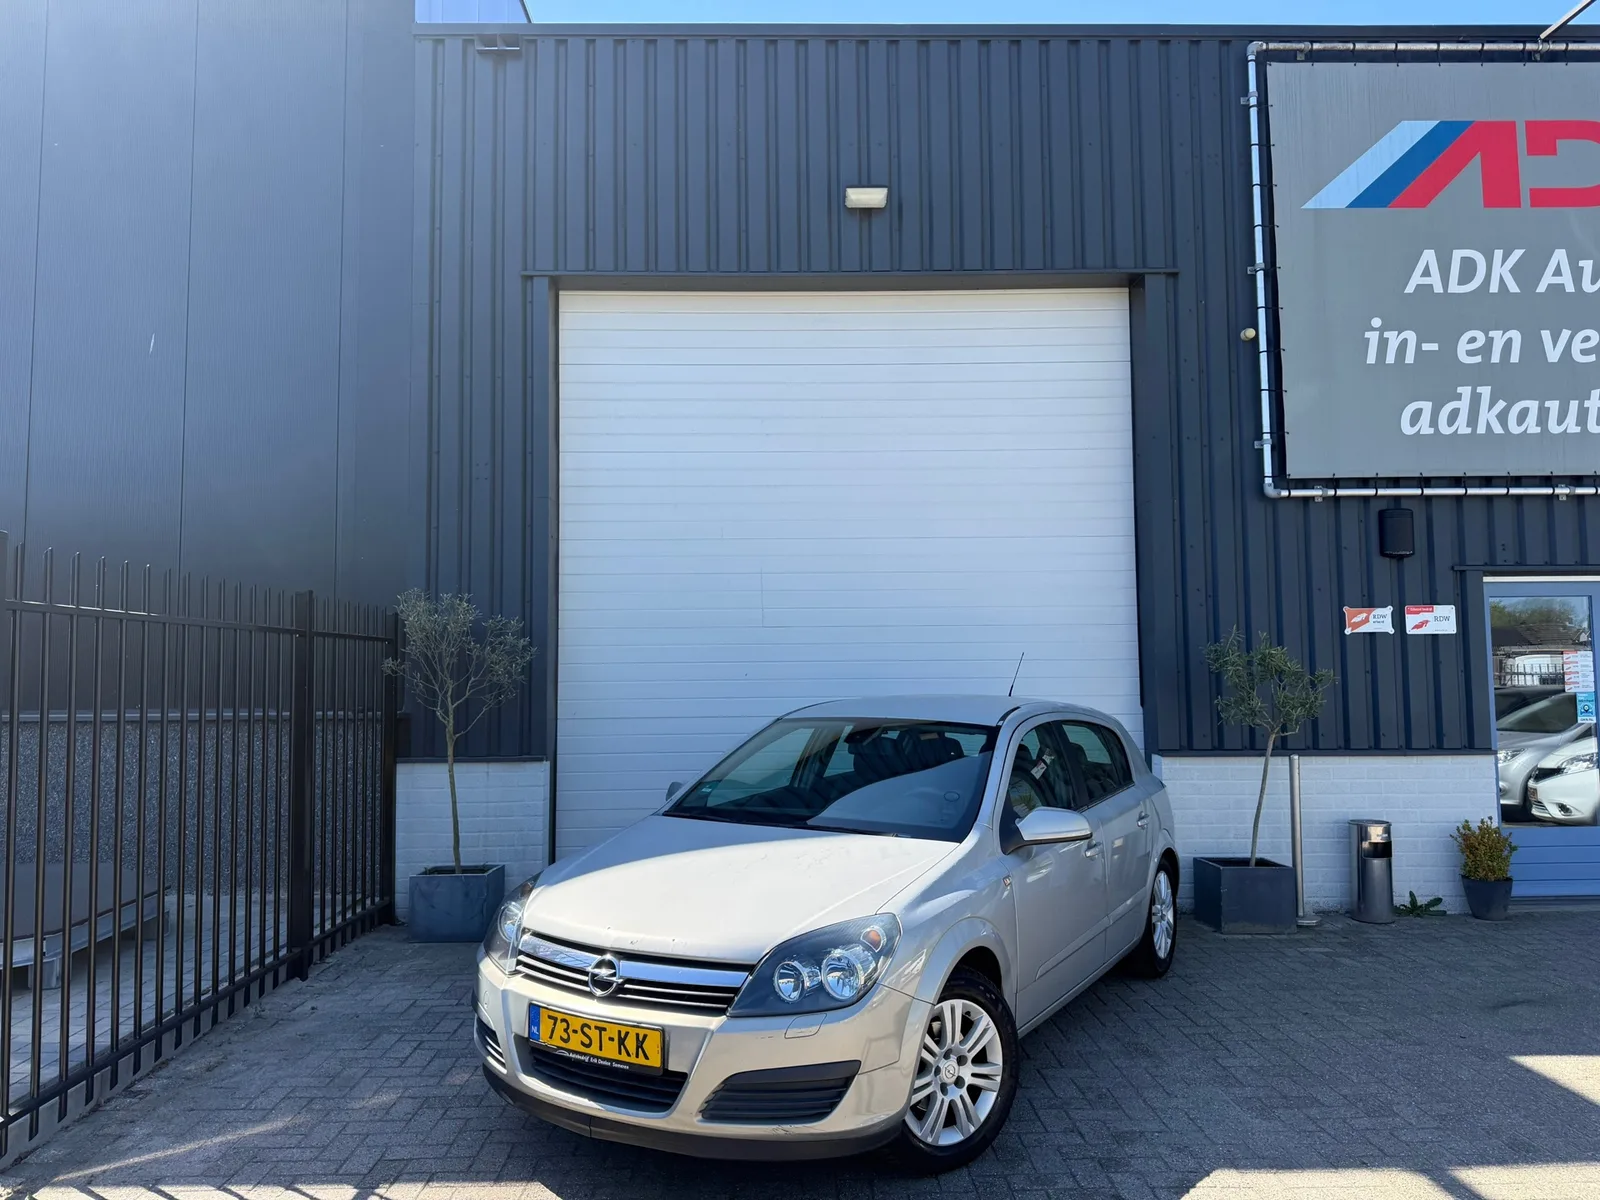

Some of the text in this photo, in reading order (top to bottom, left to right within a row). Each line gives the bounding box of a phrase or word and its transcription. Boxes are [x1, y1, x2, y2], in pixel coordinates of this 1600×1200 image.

[1403, 248, 1526, 294] ADK
[1364, 317, 1600, 364] in- en ve
[1400, 386, 1600, 436] adkaut
[531, 1025, 539, 1035] NL
[547, 1014, 650, 1061] 73-ST-KK
